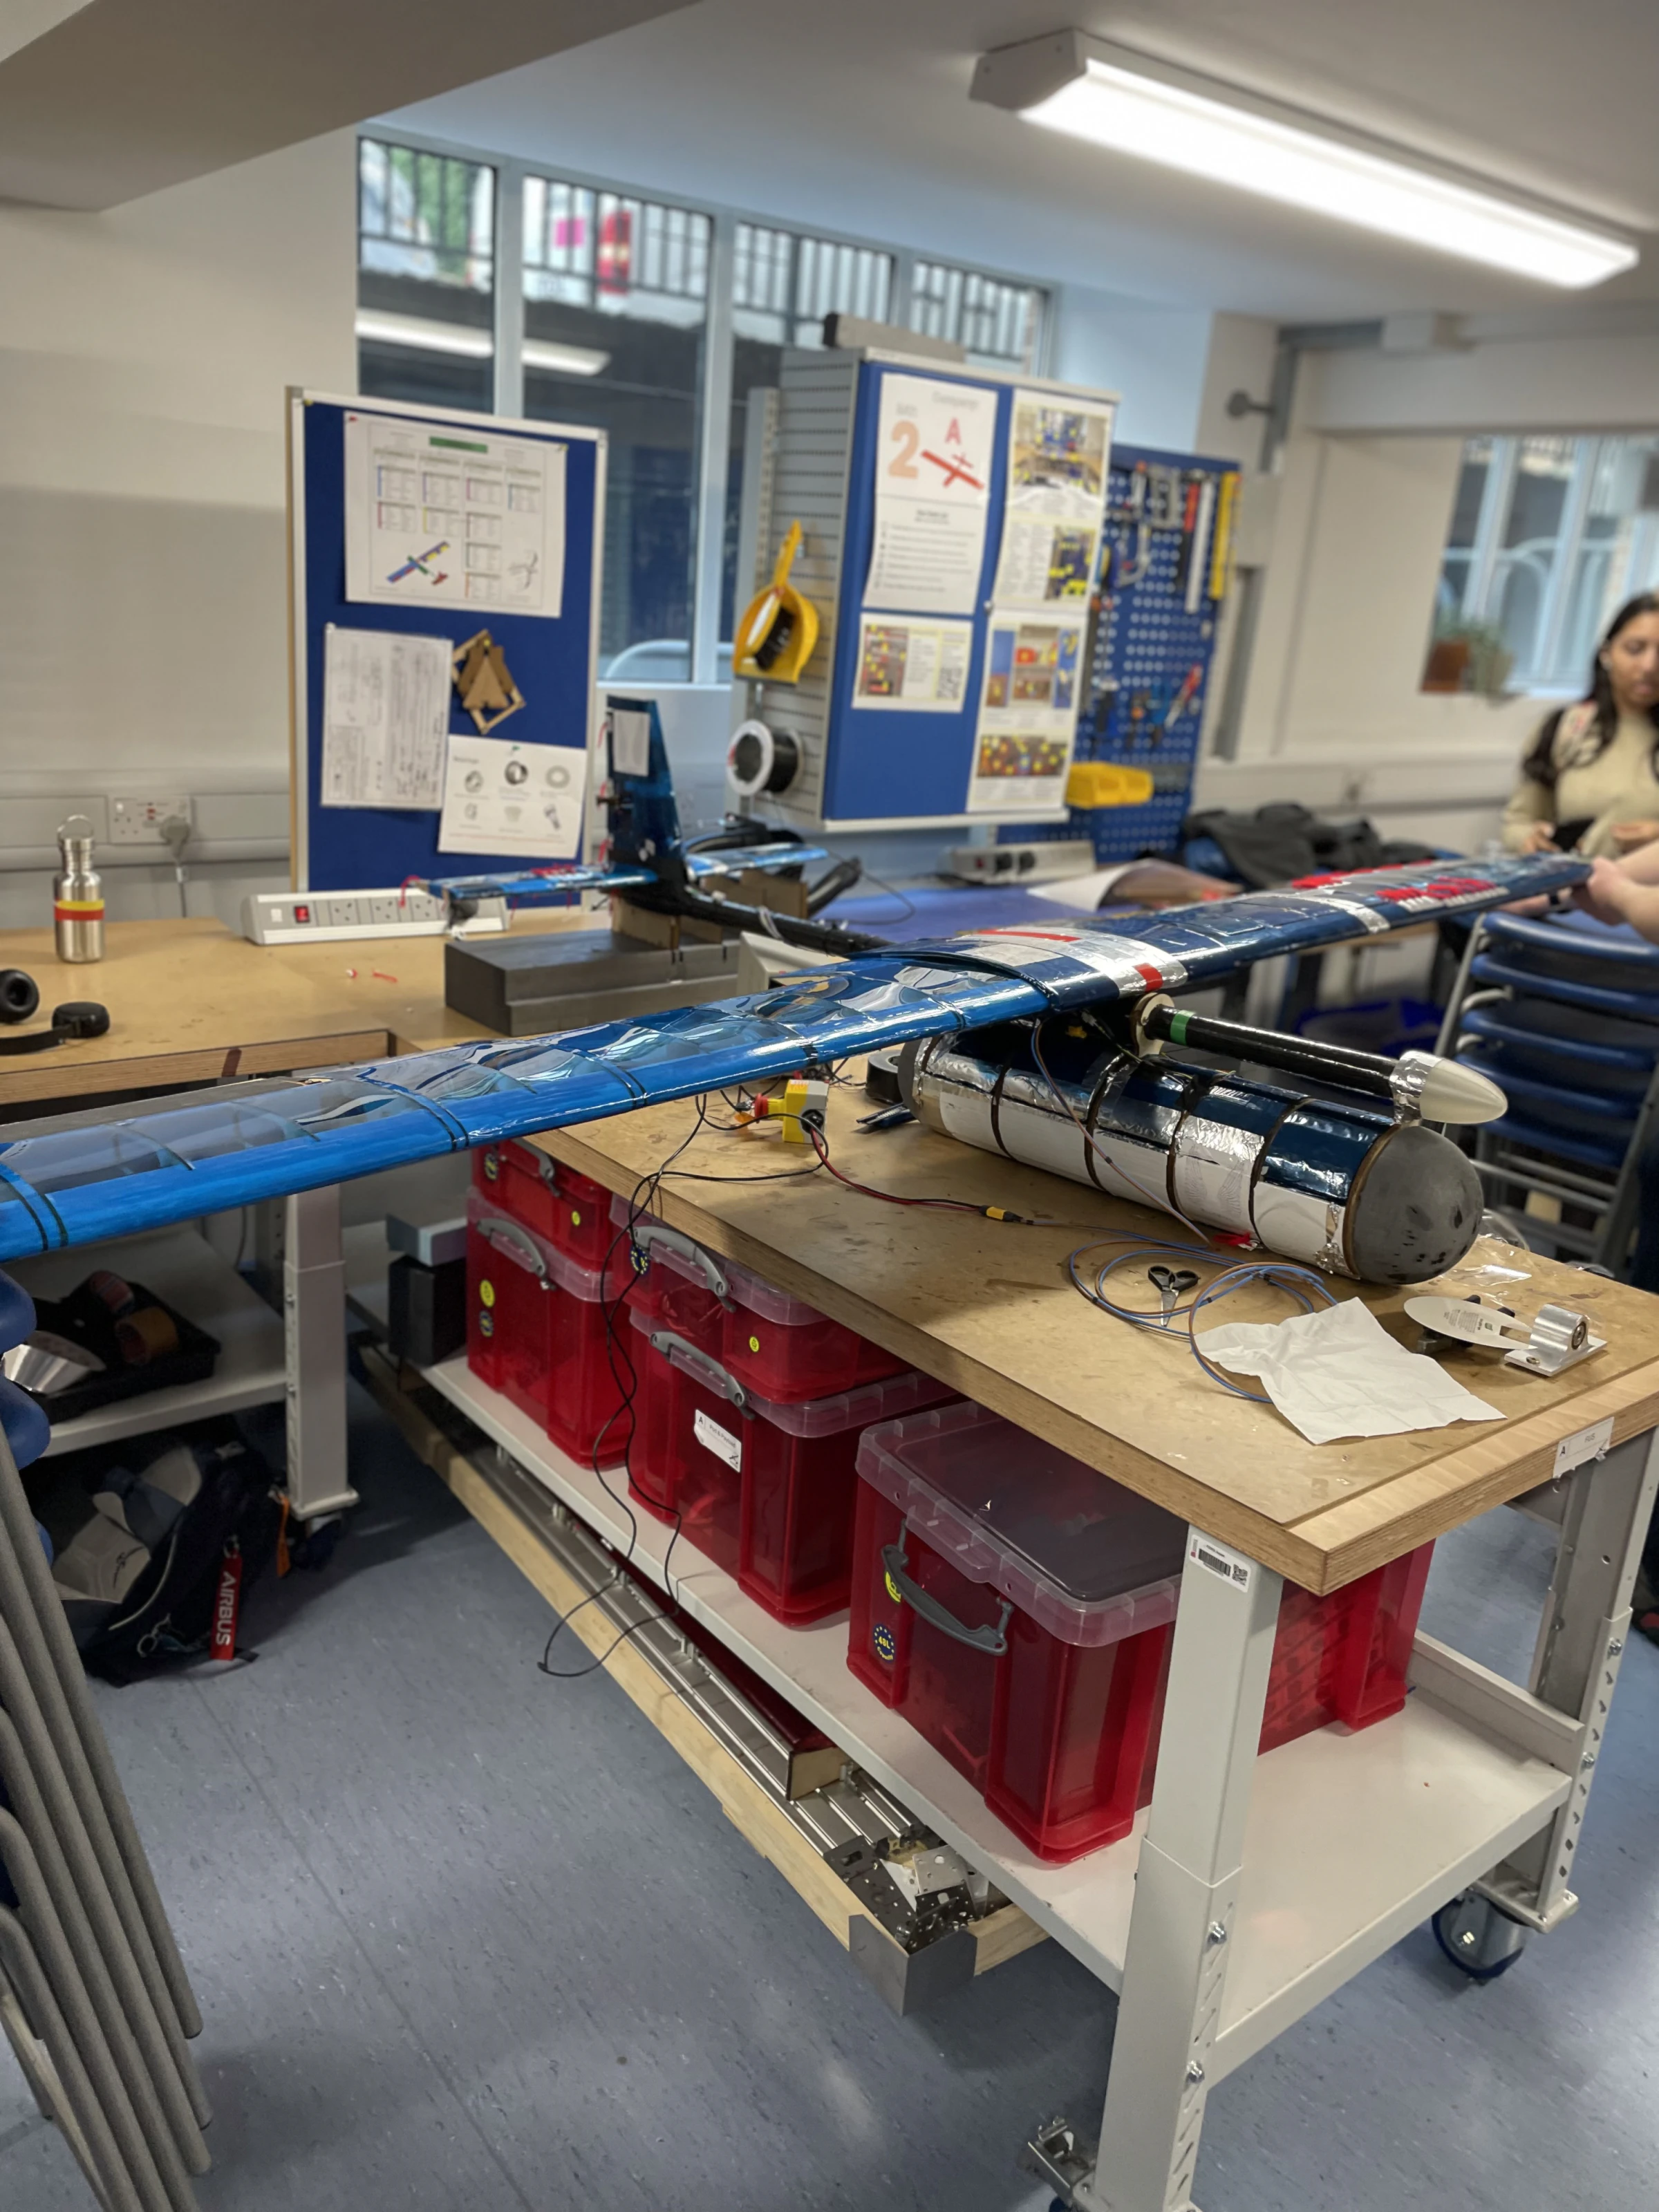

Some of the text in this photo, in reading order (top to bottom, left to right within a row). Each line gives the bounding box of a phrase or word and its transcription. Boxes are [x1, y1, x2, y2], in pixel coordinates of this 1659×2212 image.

[944, 416, 962, 445] A
[888, 419, 919, 479] 2
[698, 1416, 704, 1425] A
[1559, 1445, 1566, 1456] A
[216, 1571, 236, 1646] AIRBUS
